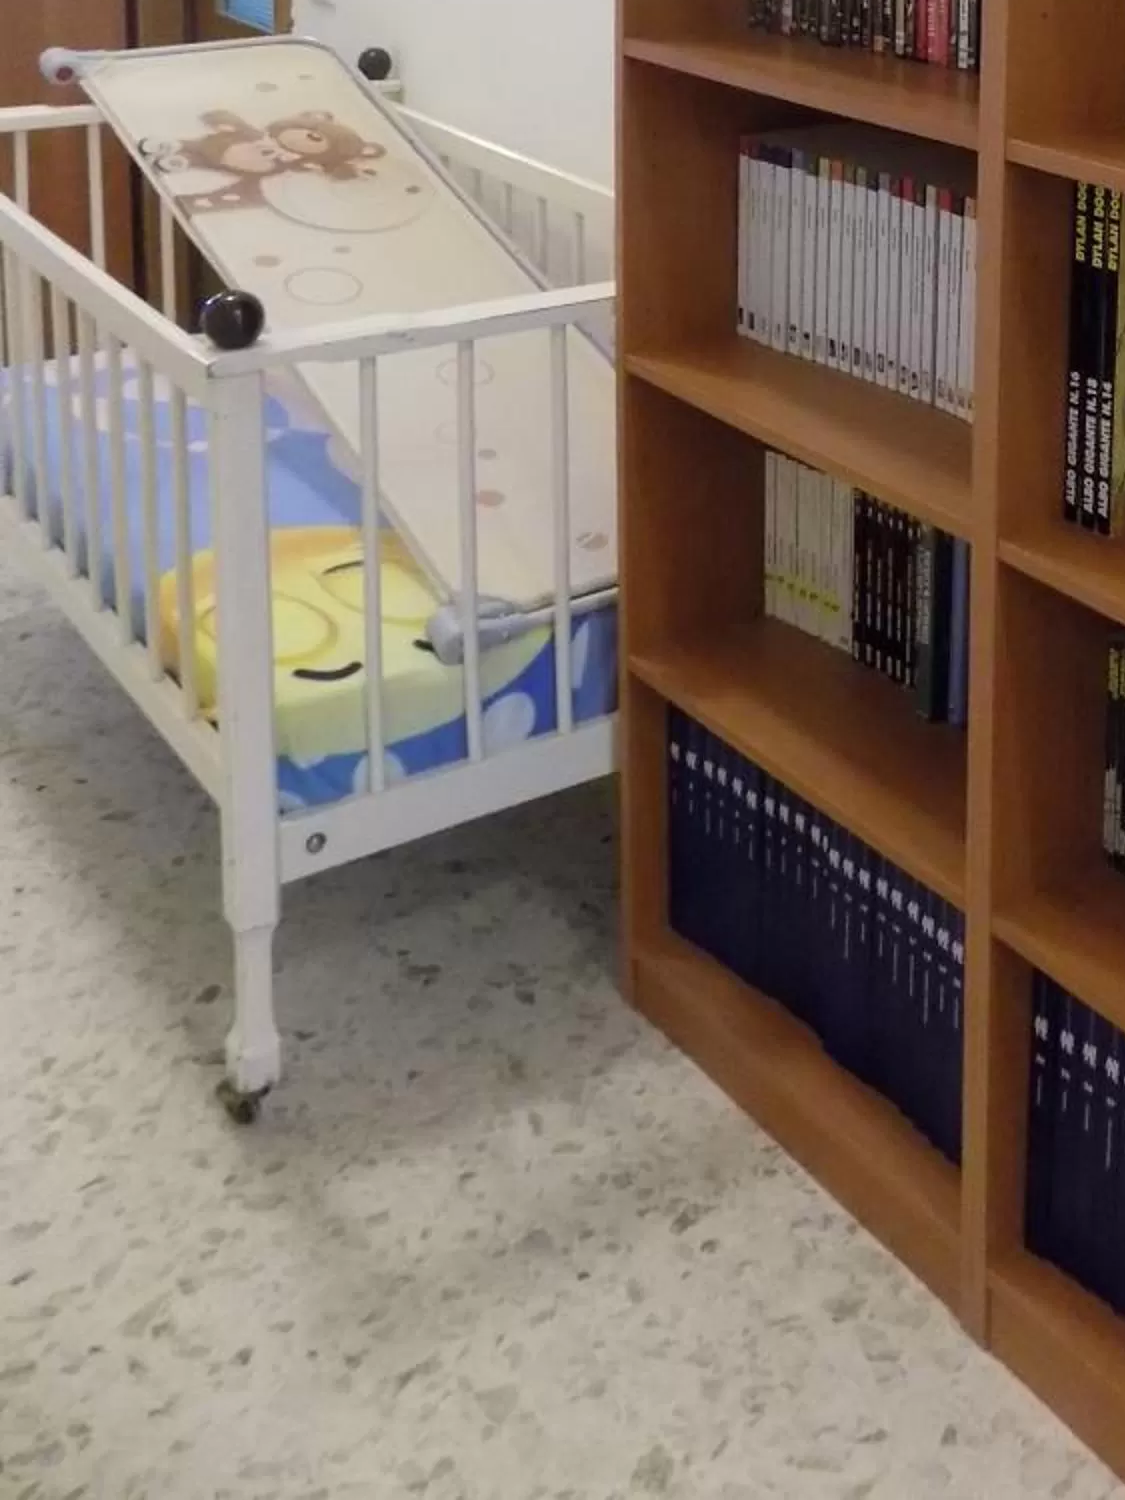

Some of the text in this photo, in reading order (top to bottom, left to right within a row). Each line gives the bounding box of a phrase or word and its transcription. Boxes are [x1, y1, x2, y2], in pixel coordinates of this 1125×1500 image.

[1075, 215, 1087, 262] DYLAN
[1091, 221, 1103, 269] DYLAN
[1108, 223, 1119, 272] DYLAN
[1069, 408, 1080, 464] GIGANTE
[1086, 416, 1097, 473] GIGANTE
[1100, 420, 1112, 478] GIGANTE
[1067, 470, 1077, 505] ALBO
[1084, 478, 1094, 513] ALBO
[1099, 482, 1109, 517] ALBO
